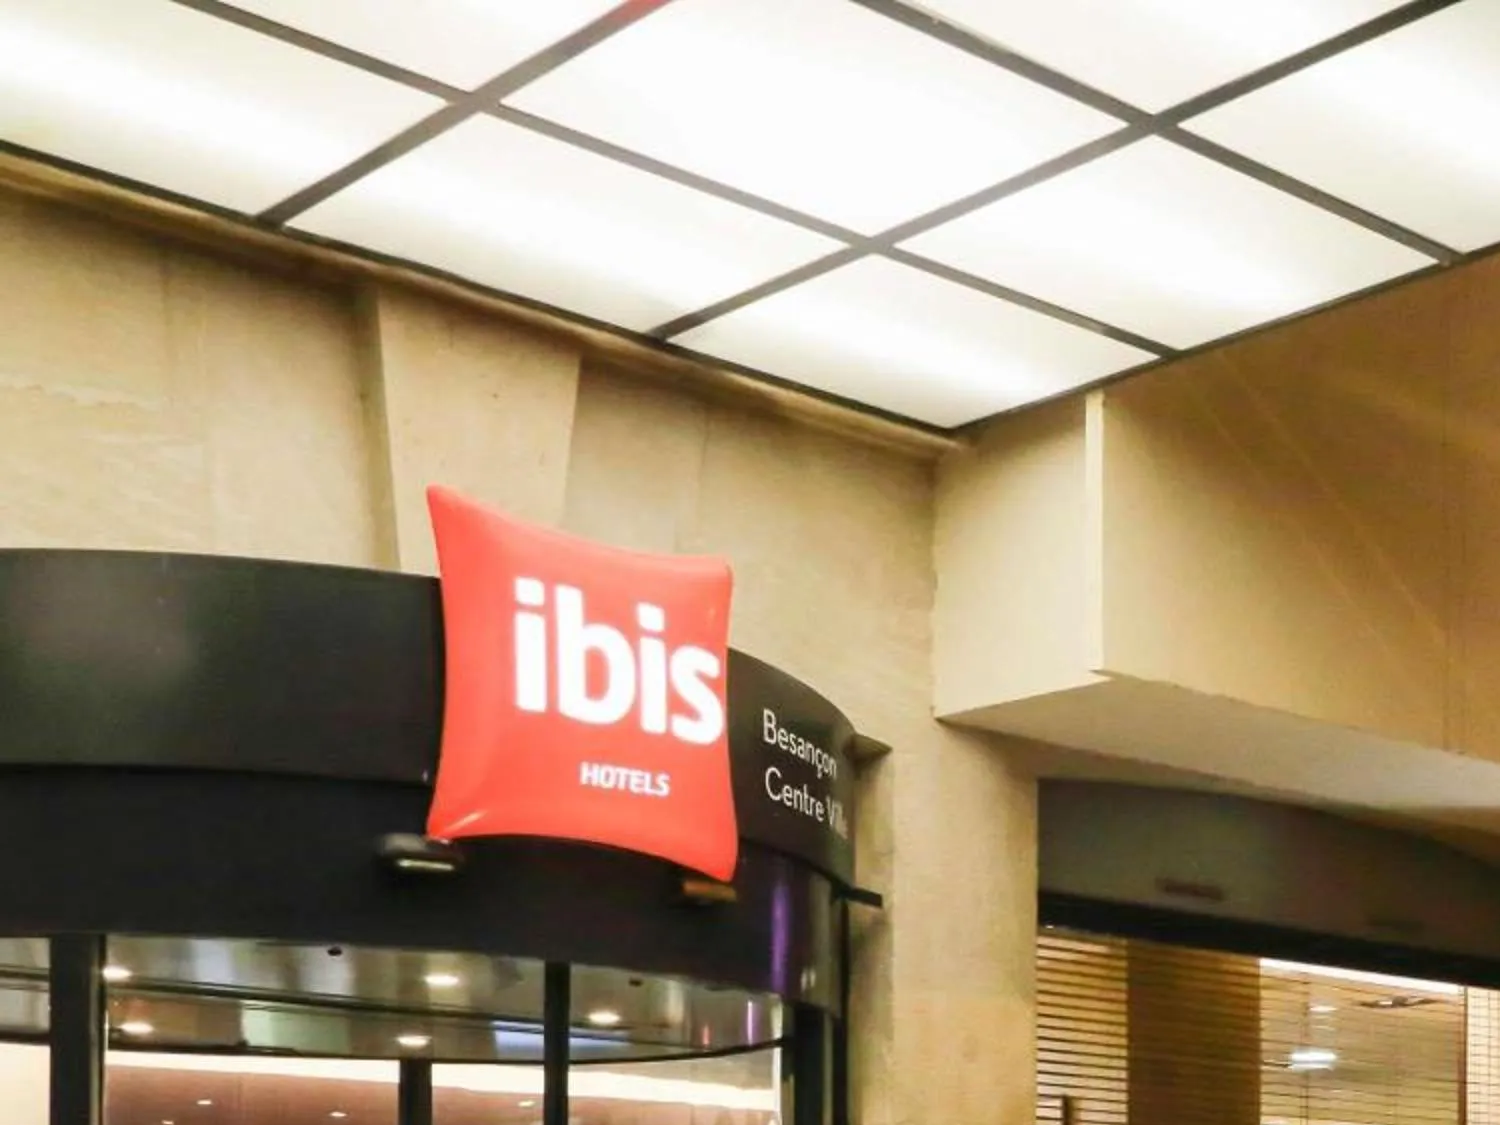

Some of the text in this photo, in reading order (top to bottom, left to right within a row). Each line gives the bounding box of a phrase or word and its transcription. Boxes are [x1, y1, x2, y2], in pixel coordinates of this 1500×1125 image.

[513, 575, 725, 746] ibis
[762, 707, 838, 780] Besançon
[578, 760, 671, 797] HOTELS
[764, 765, 826, 823] Centre
